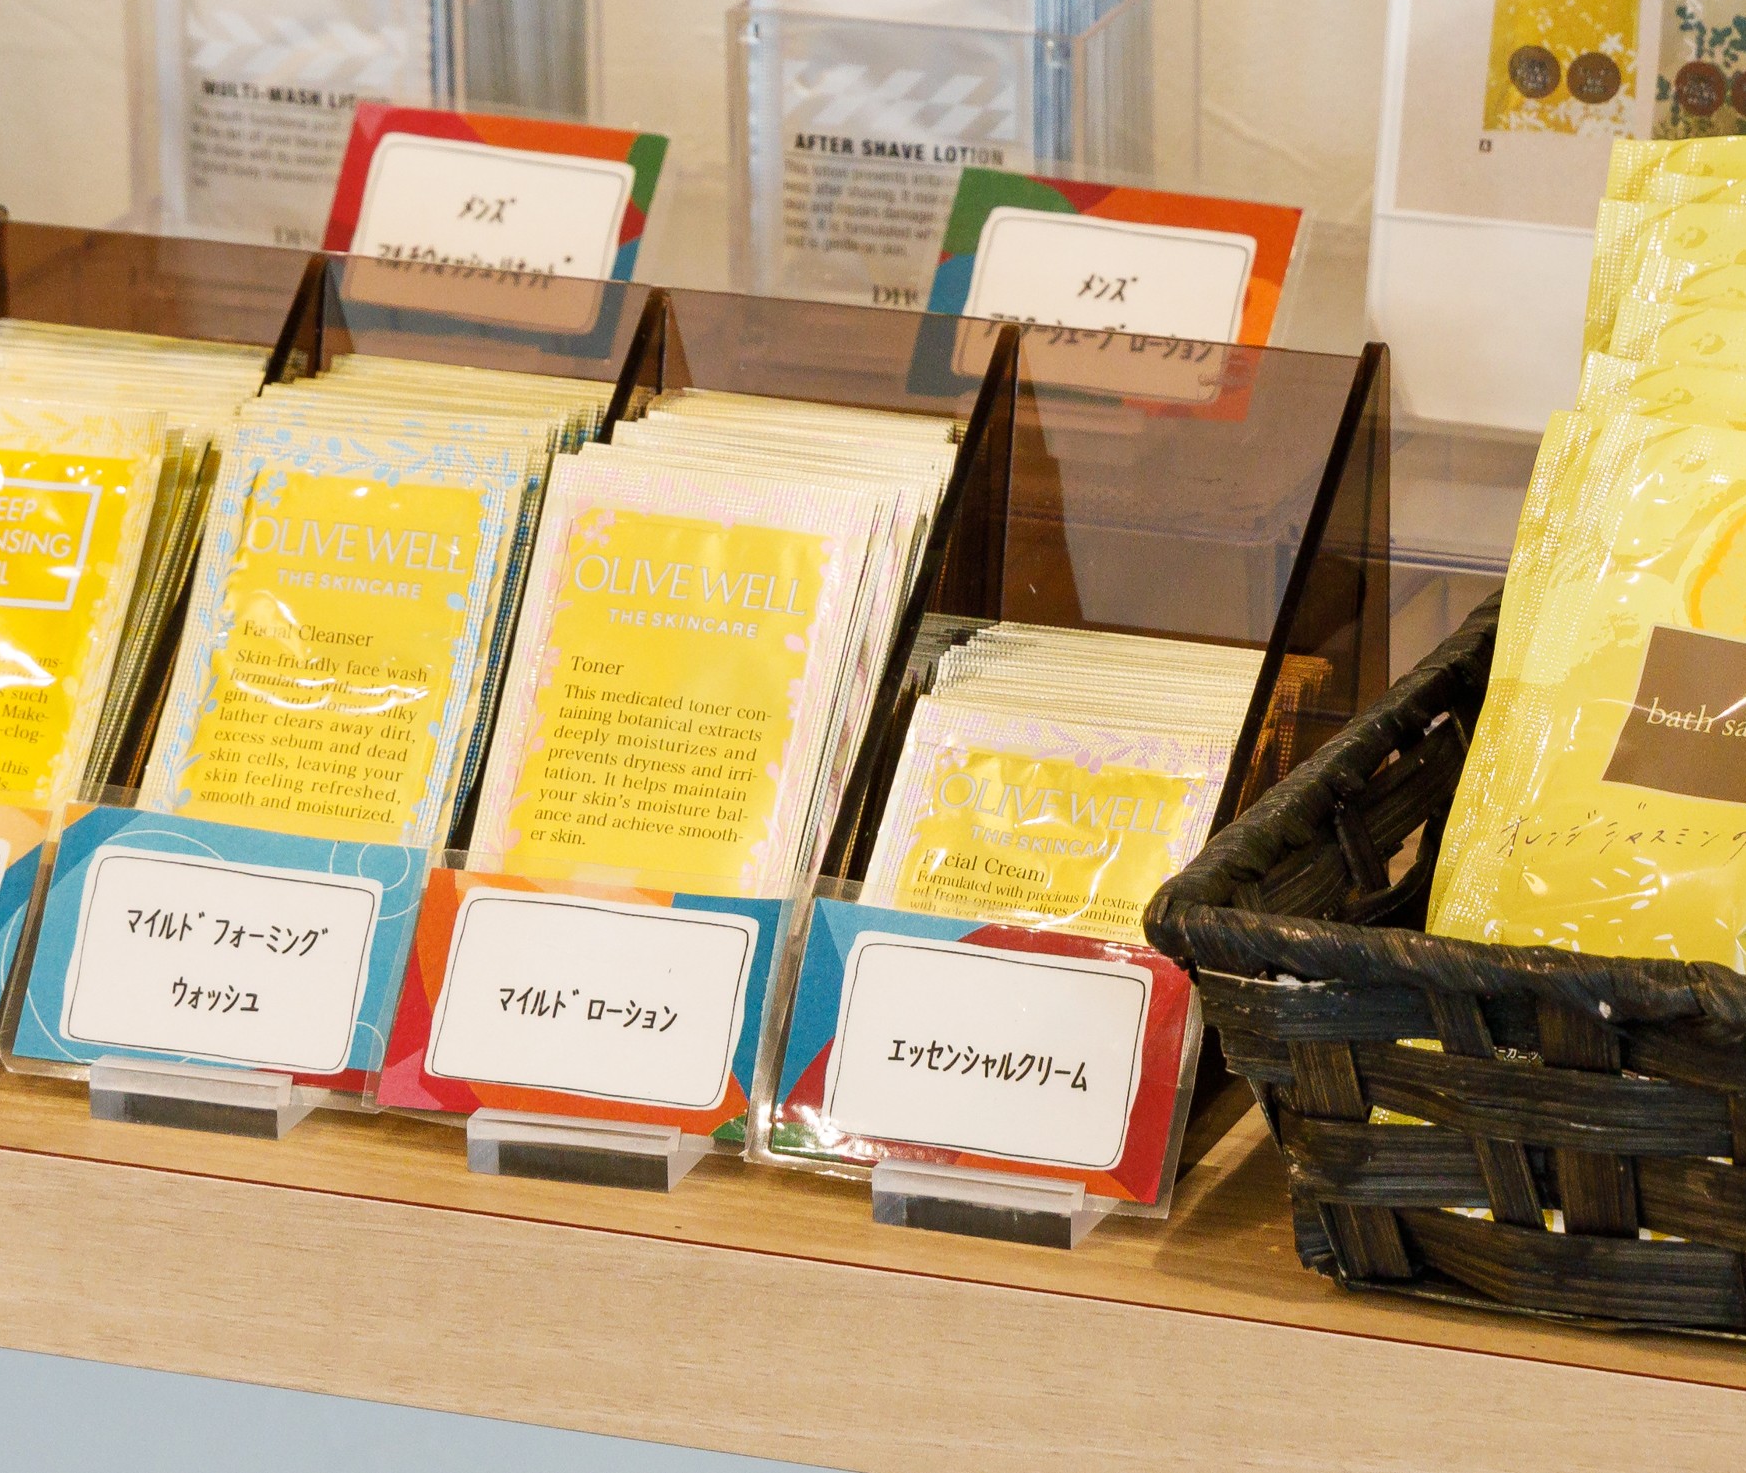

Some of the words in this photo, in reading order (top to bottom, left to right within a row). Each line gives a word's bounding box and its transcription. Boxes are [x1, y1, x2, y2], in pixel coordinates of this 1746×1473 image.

[794, 133, 853, 155] AFTER
[862, 138, 925, 161] SHAVE
[934, 145, 1004, 165] LOTION
[457, 194, 516, 223] メンズ
[1077, 273, 1138, 302] メンズ
[247, 514, 359, 564] OLIVE
[366, 524, 467, 575] WELL
[277, 568, 316, 588] THE
[320, 572, 423, 601] SKINCARE
[574, 553, 697, 602] OLIVE
[701, 566, 809, 616] WELL
[243, 619, 292, 639] Facial
[298, 624, 373, 647] Cleanser
[609, 607, 649, 627] THE
[650, 611, 759, 640] SKINCARE
[235, 648, 340, 674] Skin-friendly
[346, 660, 380, 677] face
[387, 665, 428, 683] wash
[571, 655, 624, 676] Toner
[2, 703, 50, 723] Make-
[564, 684, 596, 701] This
[601, 689, 683, 710] medicated
[689, 699, 732, 717] toner
[737, 705, 772, 722] con-
[1646, 696, 1714, 734] bath
[219, 707, 268, 724] lather
[274, 713, 324, 731] clears
[330, 722, 373, 739] away
[380, 724, 416, 743] dirt,
[559, 705, 612, 725] taining
[618, 709, 693, 733] botanical
[698, 723, 763, 742] extracts
[554, 725, 611, 746] deeply
[617, 732, 717, 758] moisturizes
[724, 747, 757, 762] and
[548, 746, 618, 766] prevents
[624, 753, 686, 774] dryness
[692, 762, 723, 779] and
[728, 766, 758, 782] irri-
[204, 769, 238, 784] skin
[245, 770, 304, 793] feeling
[311, 777, 402, 805] refreshed,
[938, 771, 1060, 823] OLIVE
[1070, 790, 1173, 836] WELL
[200, 788, 255, 807] smooth
[260, 794, 290, 810] and
[296, 796, 396, 824] moisturized.
[534, 807, 572, 822] ance
[576, 810, 607, 827] and
[612, 814, 674, 834] achieve
[678, 824, 744, 843] smooth-
[970, 825, 1014, 846] THE
[985, 857, 1046, 882] Cream
[916, 870, 992, 894] Formulated
[996, 881, 1024, 899] with
[1027, 888, 1080, 906] precious
[171, 980, 261, 1015] ウォッシュ
[888, 1038, 1088, 1094] エッセンシャルクリーム
